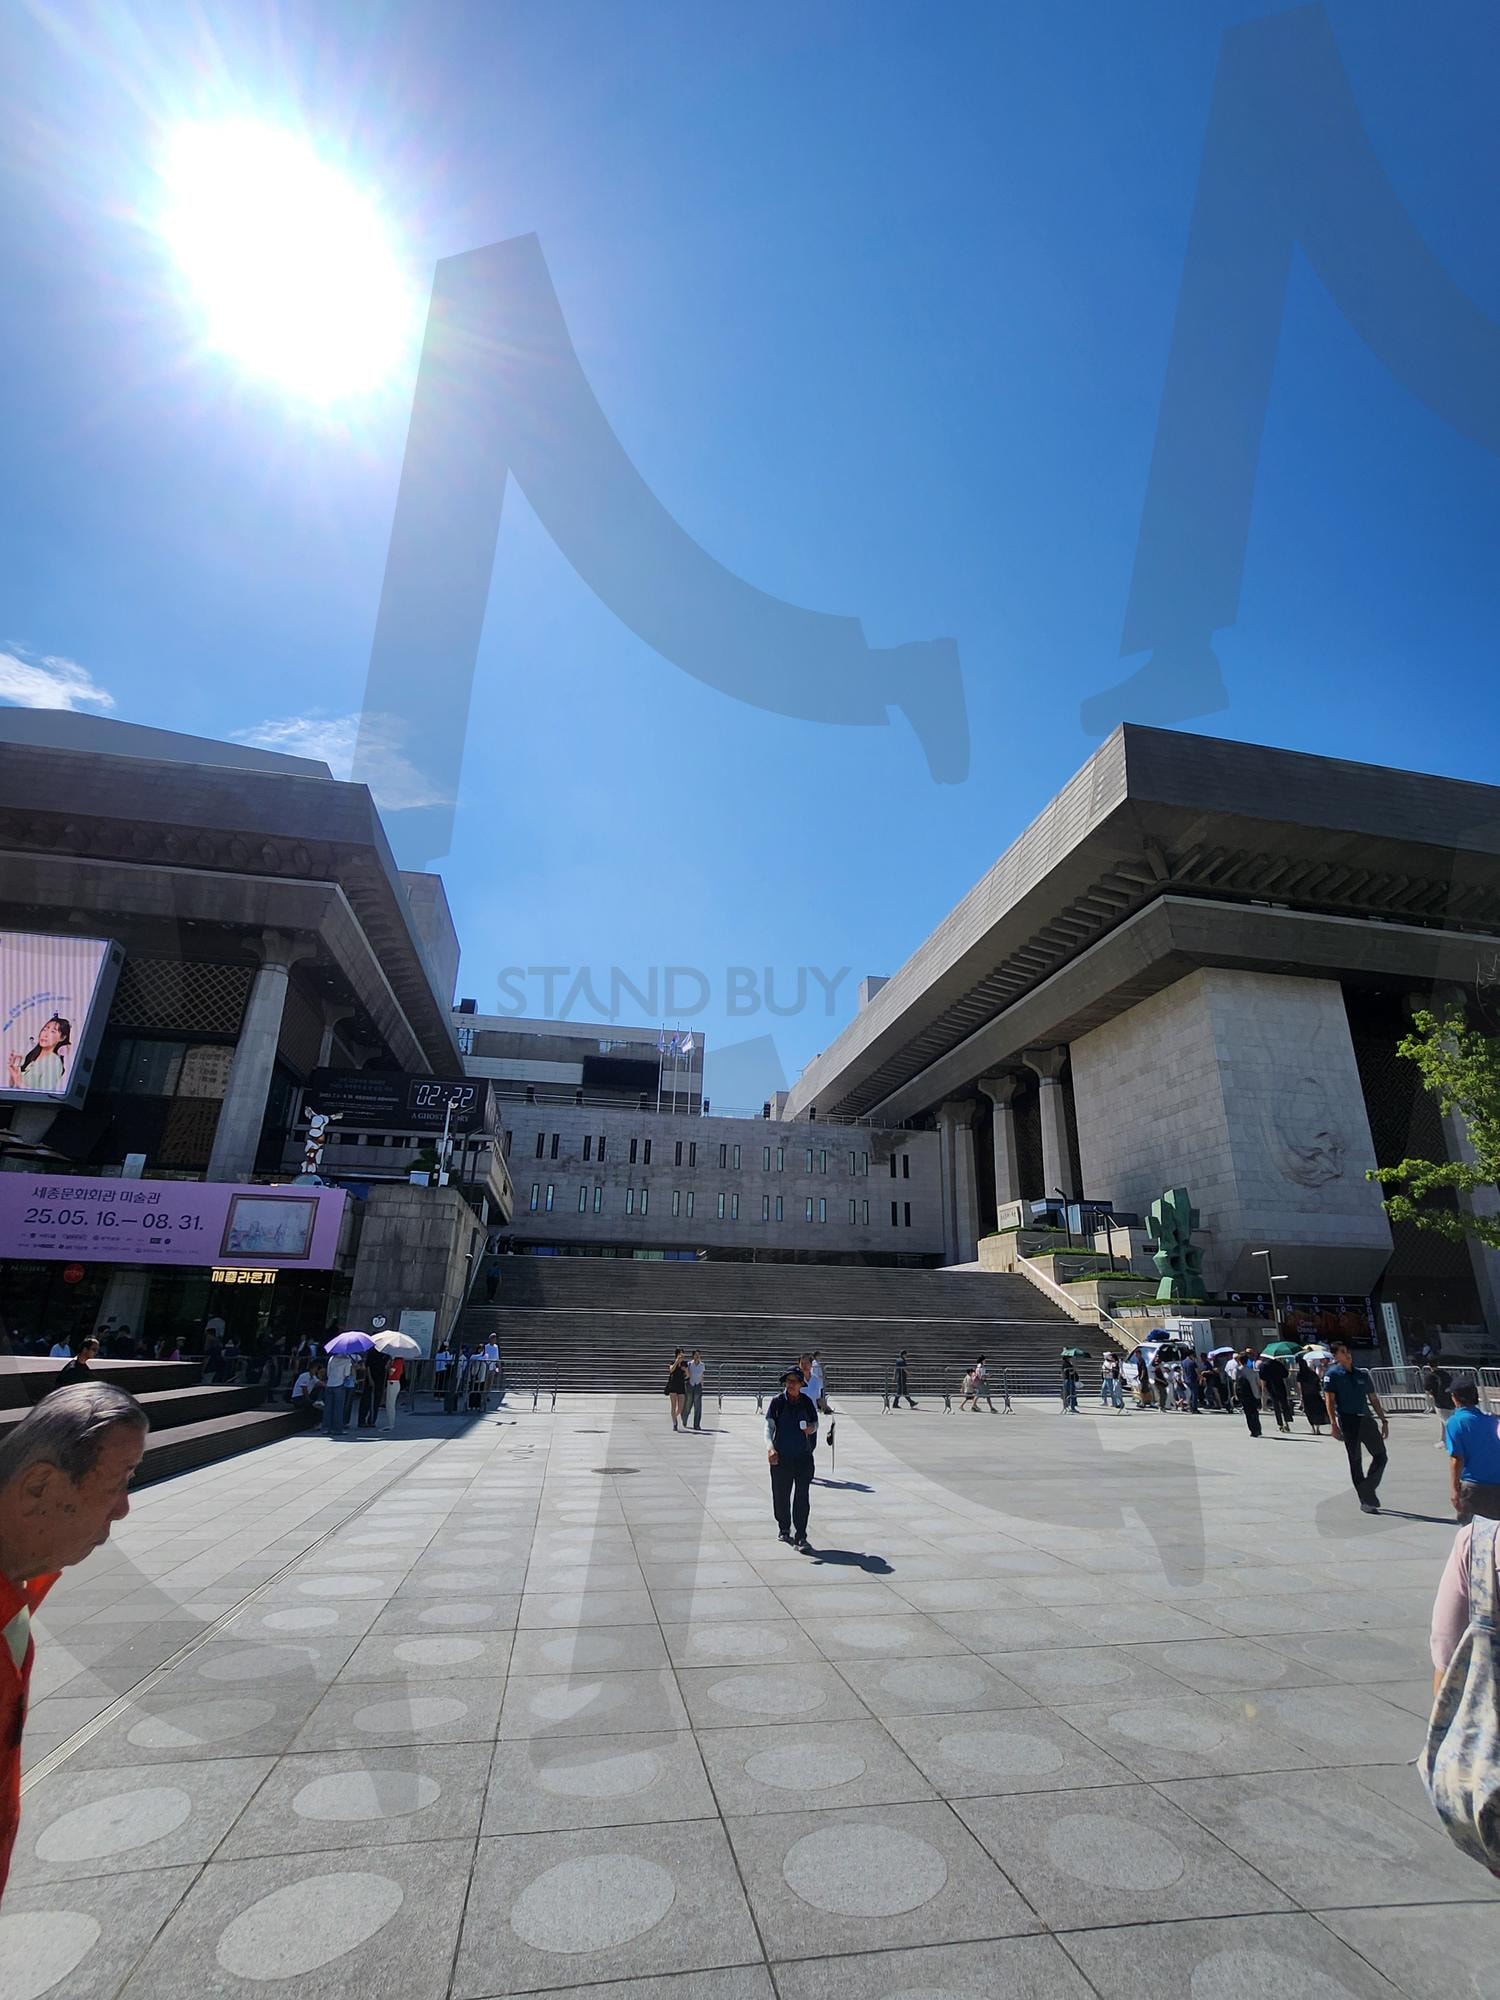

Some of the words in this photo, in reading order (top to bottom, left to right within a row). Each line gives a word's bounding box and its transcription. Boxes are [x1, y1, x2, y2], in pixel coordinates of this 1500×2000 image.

[416, 1084, 474, 1108] 02:22
[32, 1186, 116, 1203] 세종문화회관
[120, 1190, 161, 1205] 미술관
[211, 1270, 277, 1284] 세종라운지
